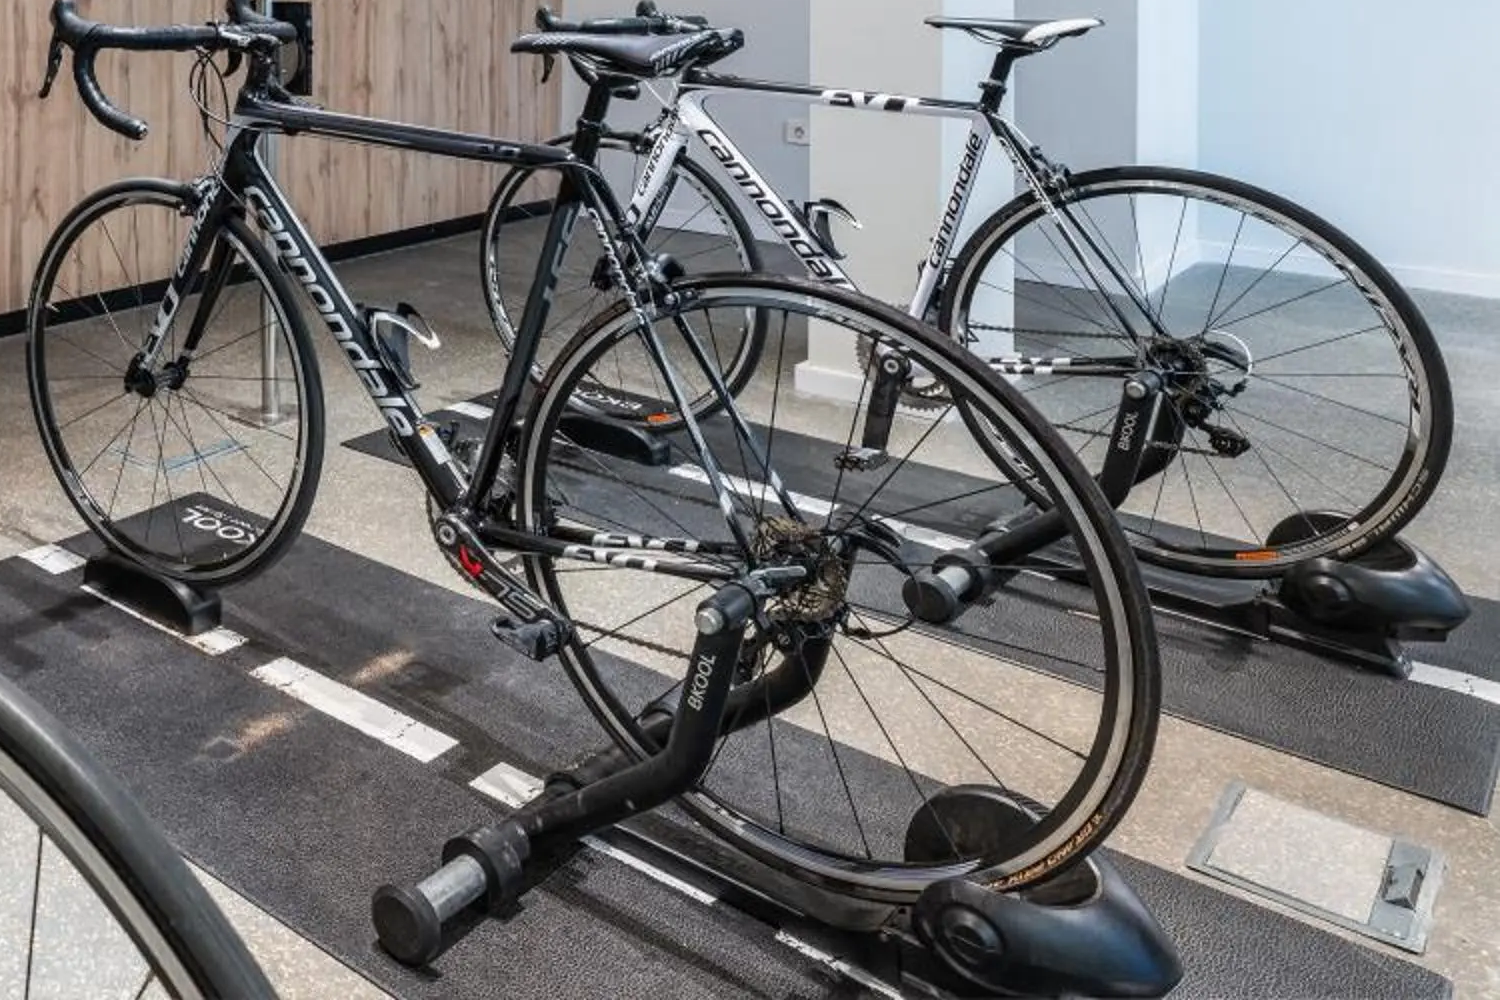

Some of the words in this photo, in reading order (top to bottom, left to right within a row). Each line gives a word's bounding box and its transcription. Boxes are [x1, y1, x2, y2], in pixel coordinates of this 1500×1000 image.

[697, 129, 850, 286] cannondal
[928, 130, 984, 269] cannondale
[244, 185, 415, 438] cannondale
[1117, 411, 1139, 451] BKOOL
[181, 507, 257, 546] KOOL
[686, 652, 717, 712] BKOOL
